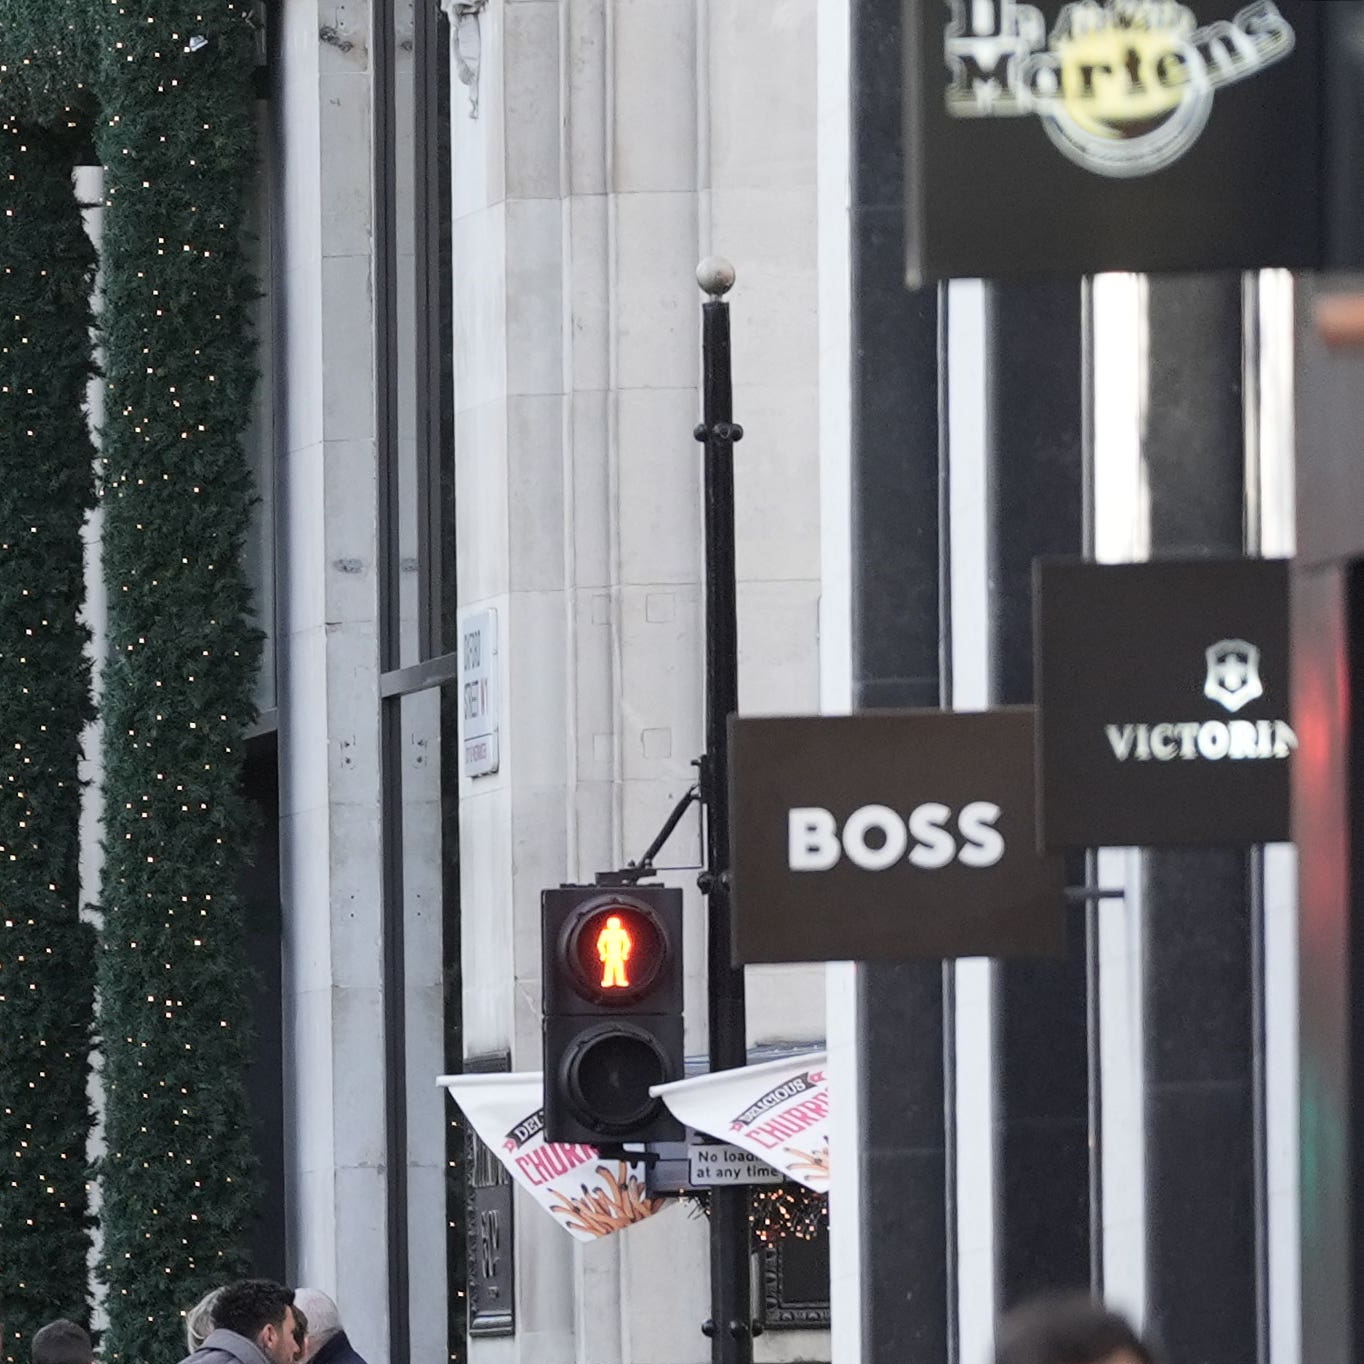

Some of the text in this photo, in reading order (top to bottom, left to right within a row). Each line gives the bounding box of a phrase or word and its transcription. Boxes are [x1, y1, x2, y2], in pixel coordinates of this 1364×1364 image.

[788, 801, 1005, 872] BOSS
[513, 1109, 544, 1142] DEL
[744, 1088, 829, 1149] CHURR
[696, 1167, 711, 1178] at
[716, 1167, 741, 1179] any
[698, 1151, 762, 1162] No load
